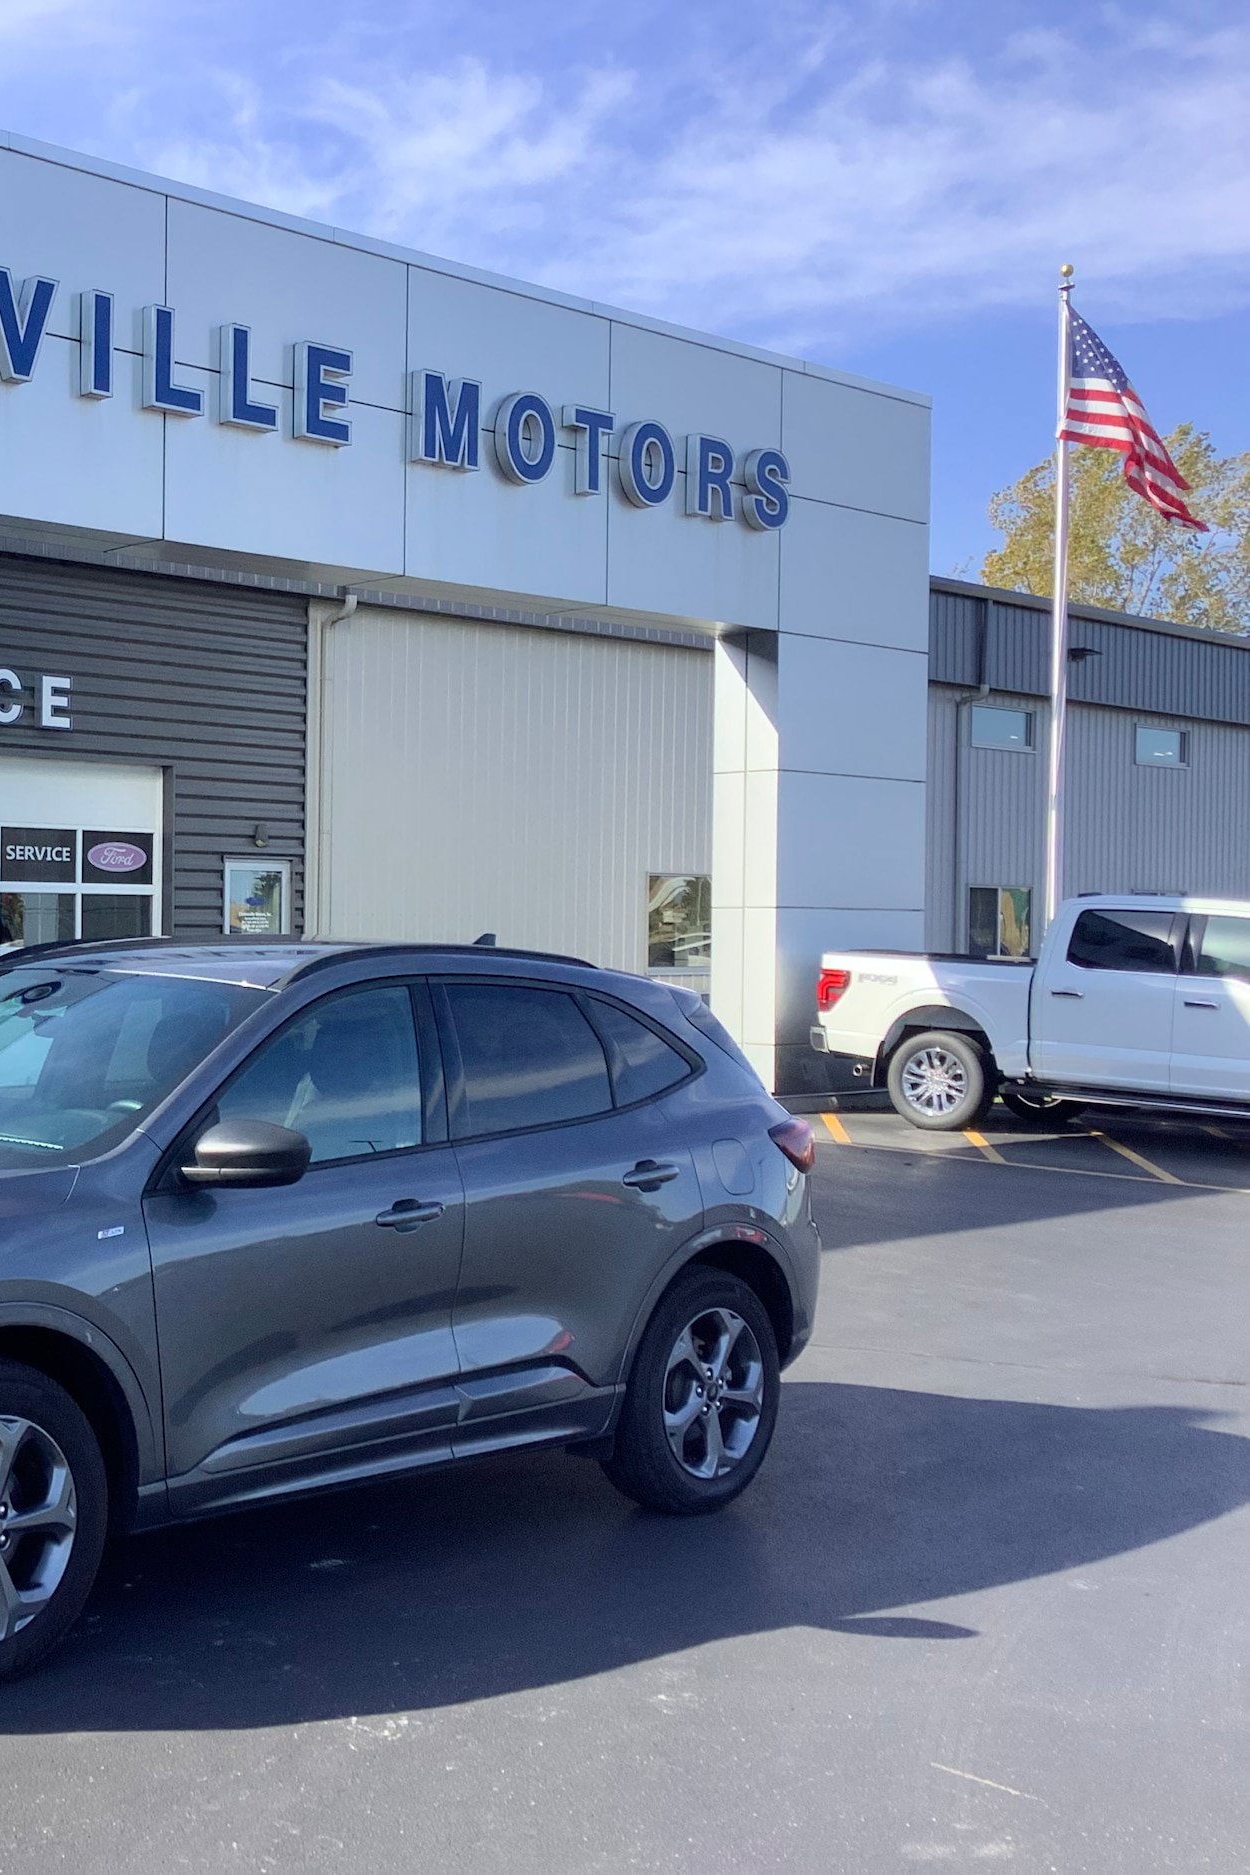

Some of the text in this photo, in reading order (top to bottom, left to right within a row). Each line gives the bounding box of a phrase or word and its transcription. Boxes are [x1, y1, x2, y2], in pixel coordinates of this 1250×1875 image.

[410, 367, 792, 533] MOTORS
[5, 845, 71, 862] SERVICE
[100, 846, 135, 866] Ford
